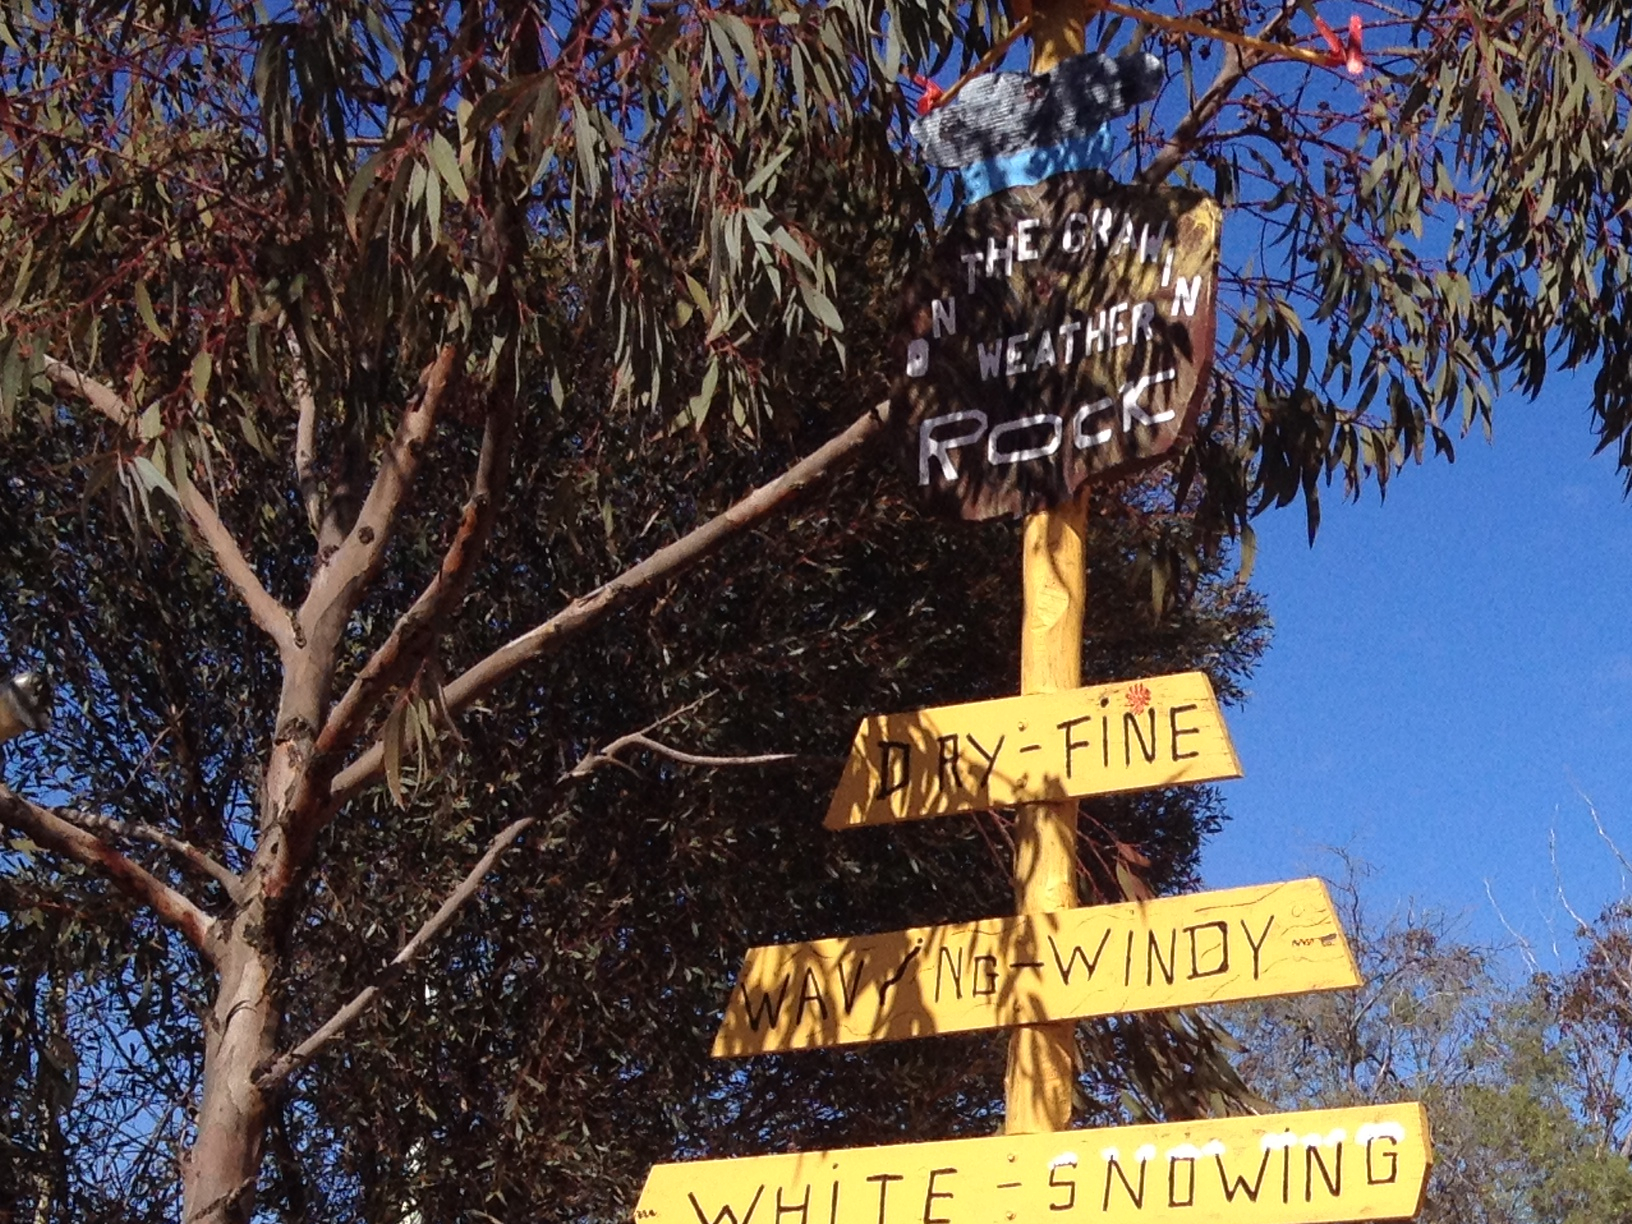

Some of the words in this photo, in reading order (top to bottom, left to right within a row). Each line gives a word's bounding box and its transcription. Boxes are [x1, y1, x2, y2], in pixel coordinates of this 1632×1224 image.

[960, 218, 1041, 296] THE
[976, 301, 1155, 382] WEATHER
[918, 368, 1176, 487] ROCK
